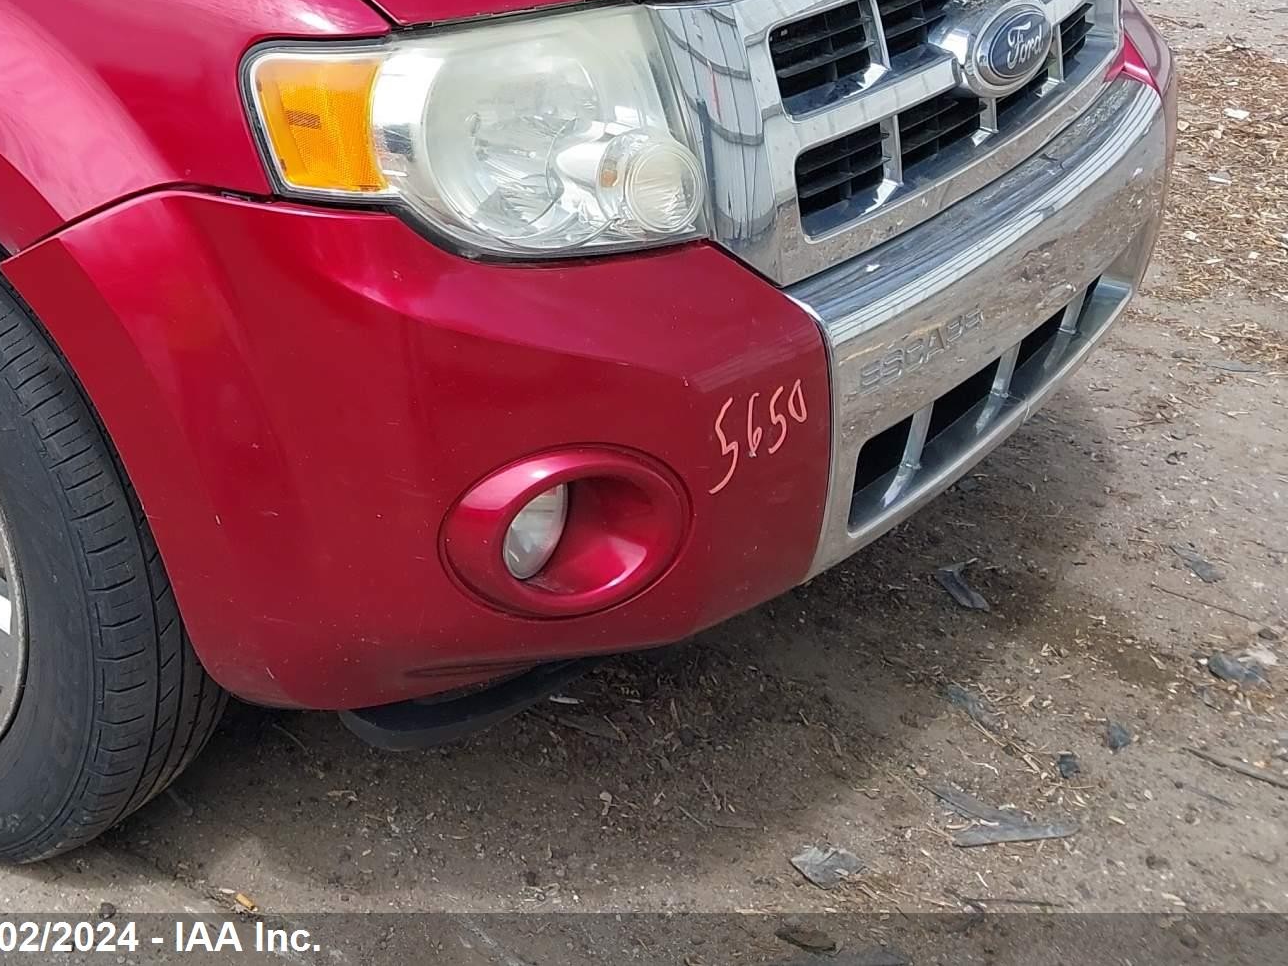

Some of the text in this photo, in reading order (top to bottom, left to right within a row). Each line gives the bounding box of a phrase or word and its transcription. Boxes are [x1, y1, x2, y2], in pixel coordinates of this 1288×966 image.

[1007, 21, 1044, 70] Ford
[859, 306, 984, 395] ESCAPE
[708, 378, 808, 494] 5650
